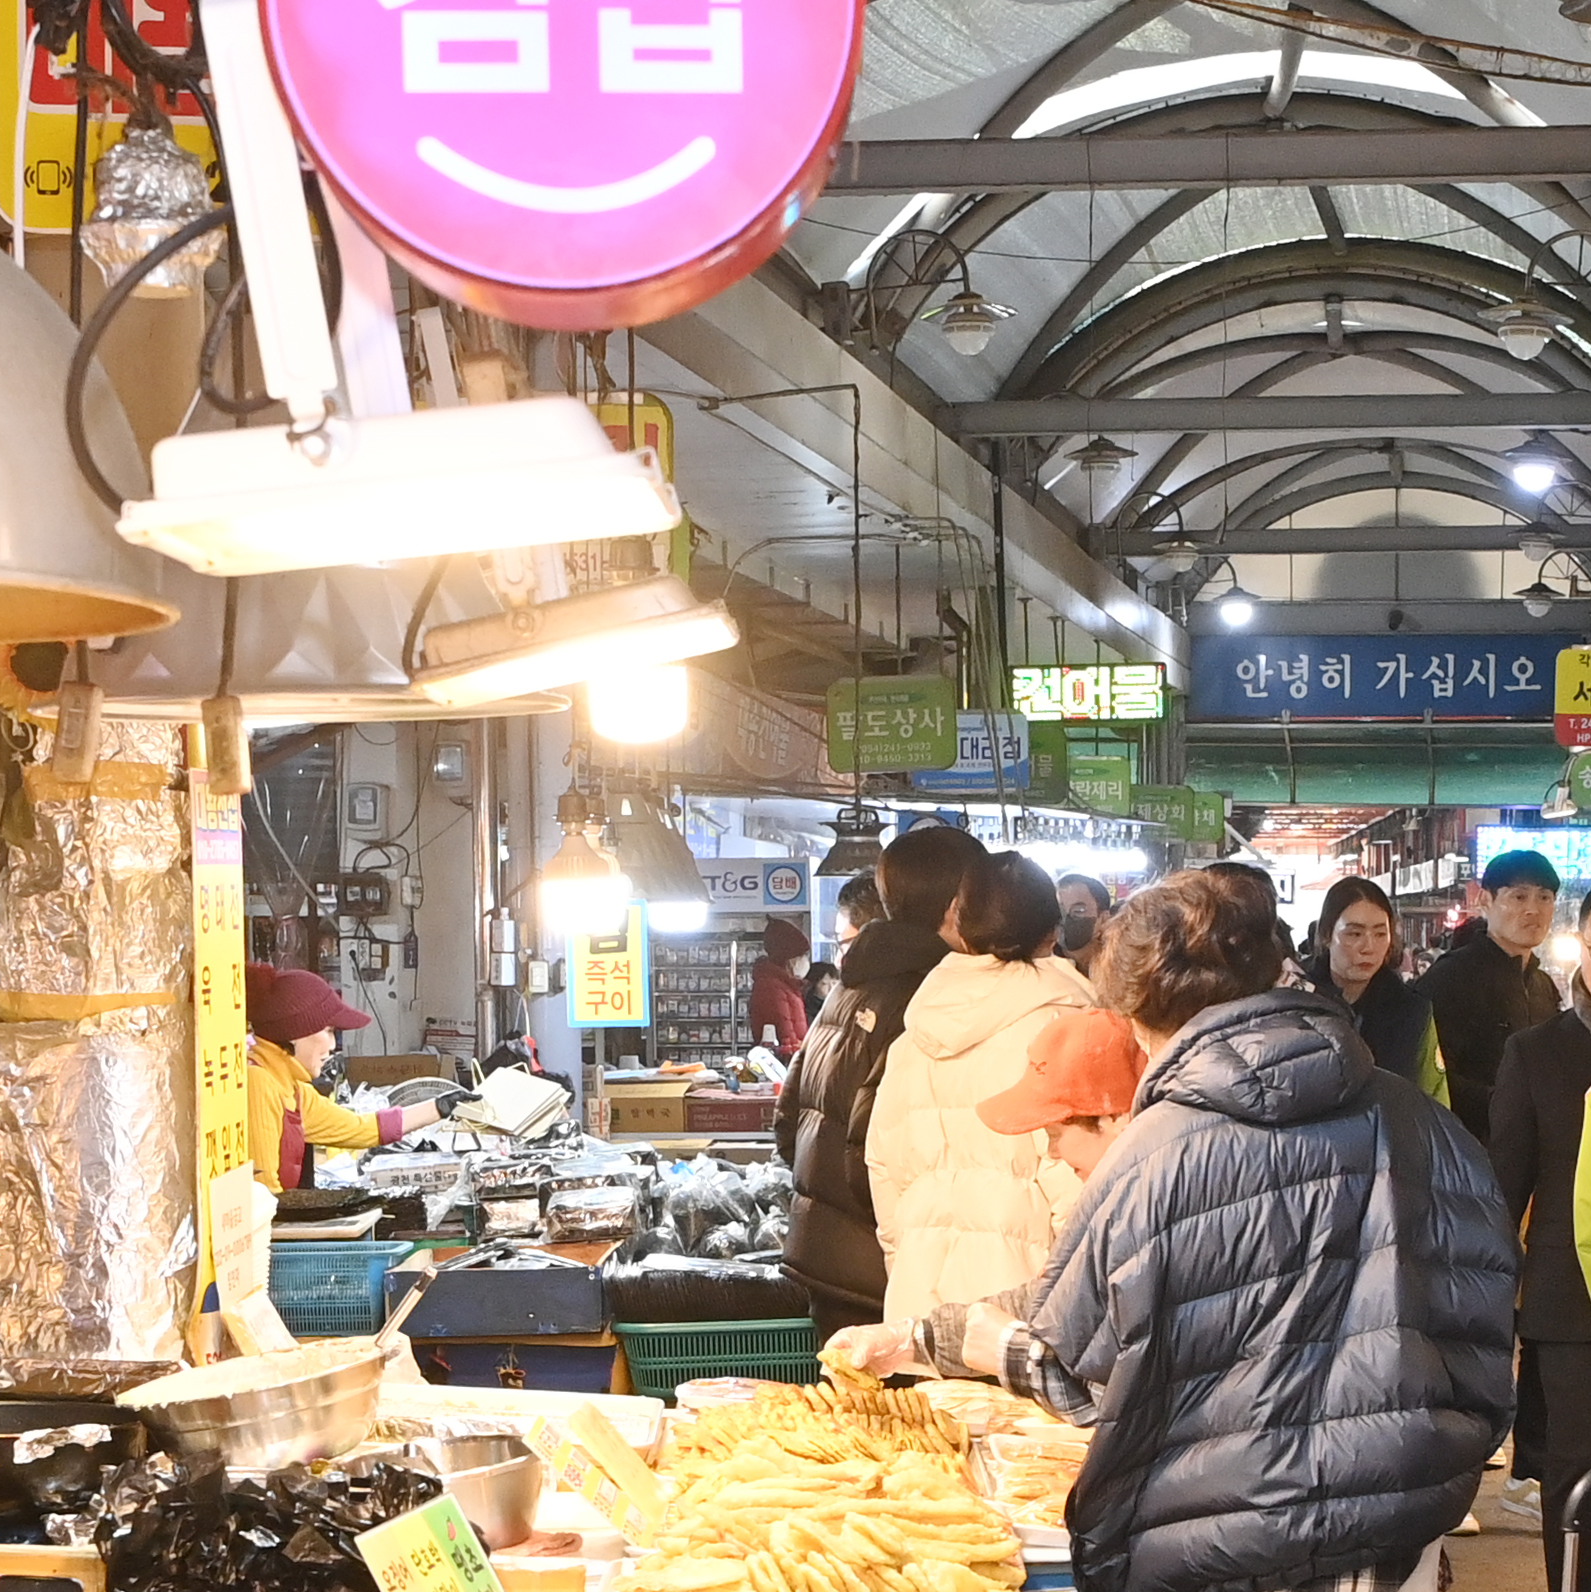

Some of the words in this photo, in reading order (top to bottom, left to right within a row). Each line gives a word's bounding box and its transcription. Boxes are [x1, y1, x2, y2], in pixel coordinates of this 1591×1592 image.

[1012, 664, 1164, 721] 건어물
[1236, 653, 1351, 699] 안녕히
[1375, 653, 1542, 699] 가십시오
[836, 706, 945, 742] 팔도상사
[1131, 803, 1185, 822] 제상회
[772, 876, 797, 890] 담배
[200, 884, 240, 935] 명태전
[584, 960, 631, 985] 즉석
[585, 990, 633, 1016] 구이
[204, 1041, 244, 1097] 녹두전
[381, 1556, 416, 1592] 오징어
